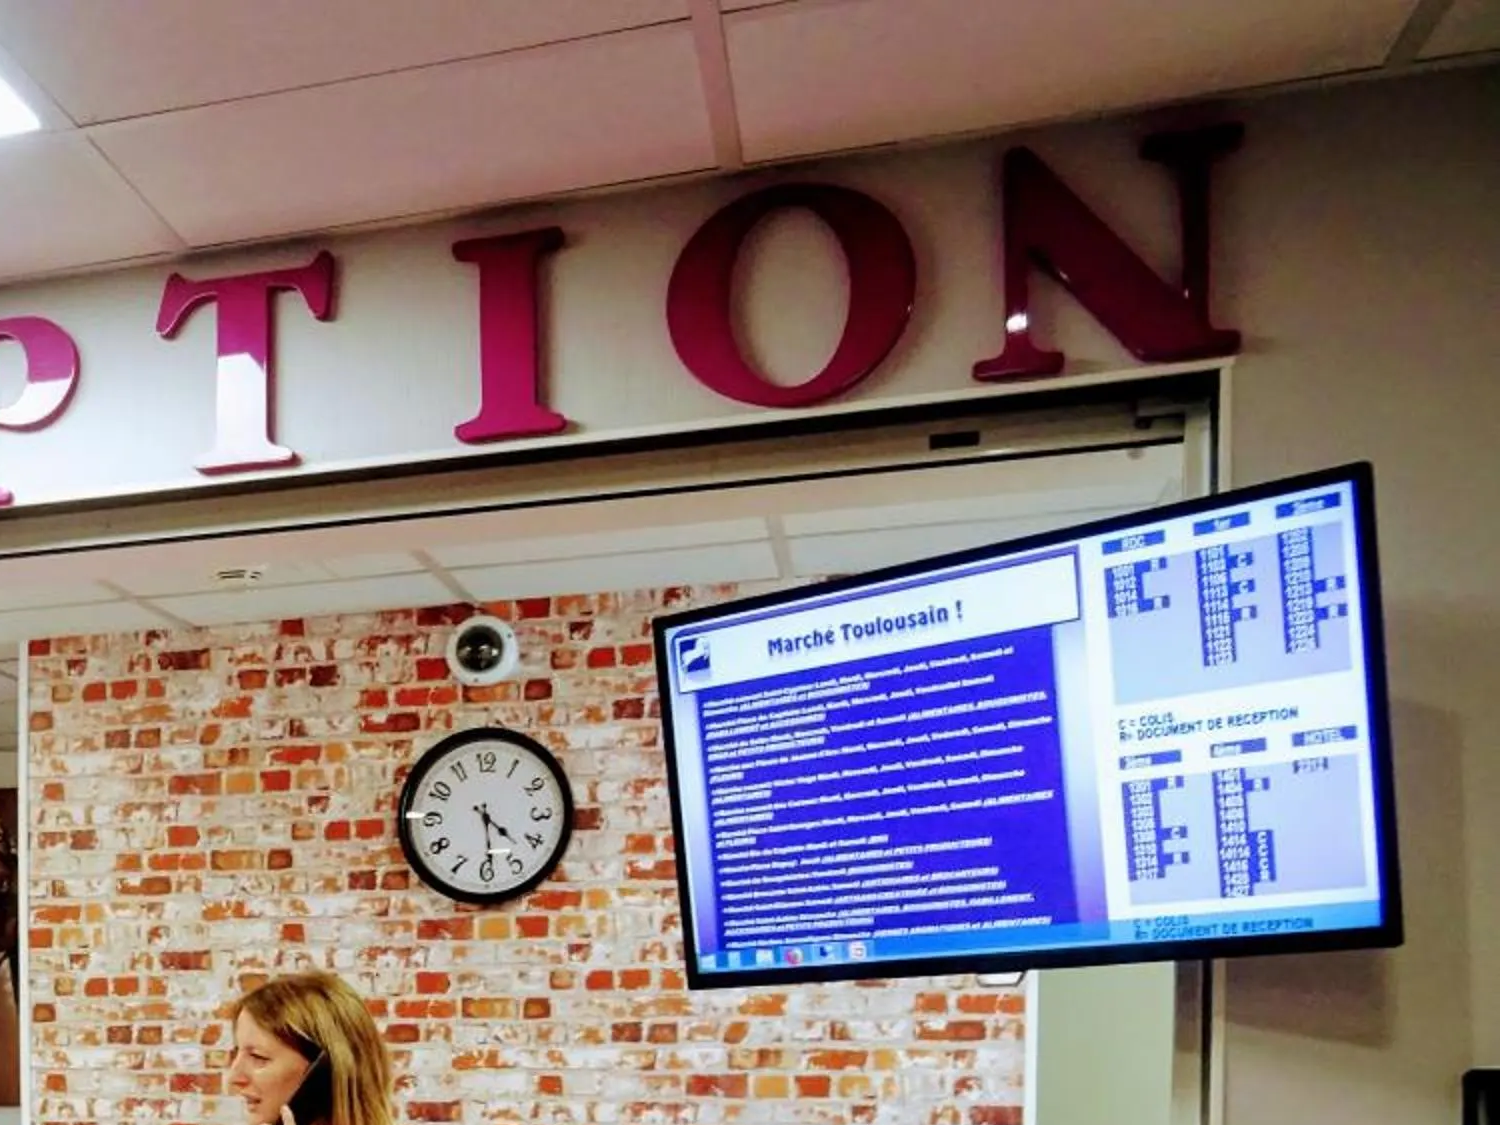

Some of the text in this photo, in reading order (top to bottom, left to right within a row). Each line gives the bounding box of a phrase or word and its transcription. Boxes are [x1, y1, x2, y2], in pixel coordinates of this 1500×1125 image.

[768, 601, 963, 656] Marché Toulousain !
[1137, 722, 1201, 740] DOCUMENT
[1206, 716, 1222, 730] DE
[1227, 707, 1299, 728] RECEPTION
[1139, 712, 1174, 727] COLIS
[450, 761, 468, 782] 11
[476, 752, 497, 773] 12
[507, 759, 519, 778] 1
[429, 781, 451, 801] 10
[524, 777, 544, 796] 2
[423, 811, 443, 827] 9
[531, 807, 552, 822] 3
[429, 837, 450, 855] 8
[525, 832, 544, 850] 4
[451, 854, 469, 875] 7
[480, 858, 494, 882] 6
[507, 853, 523, 875] 5
